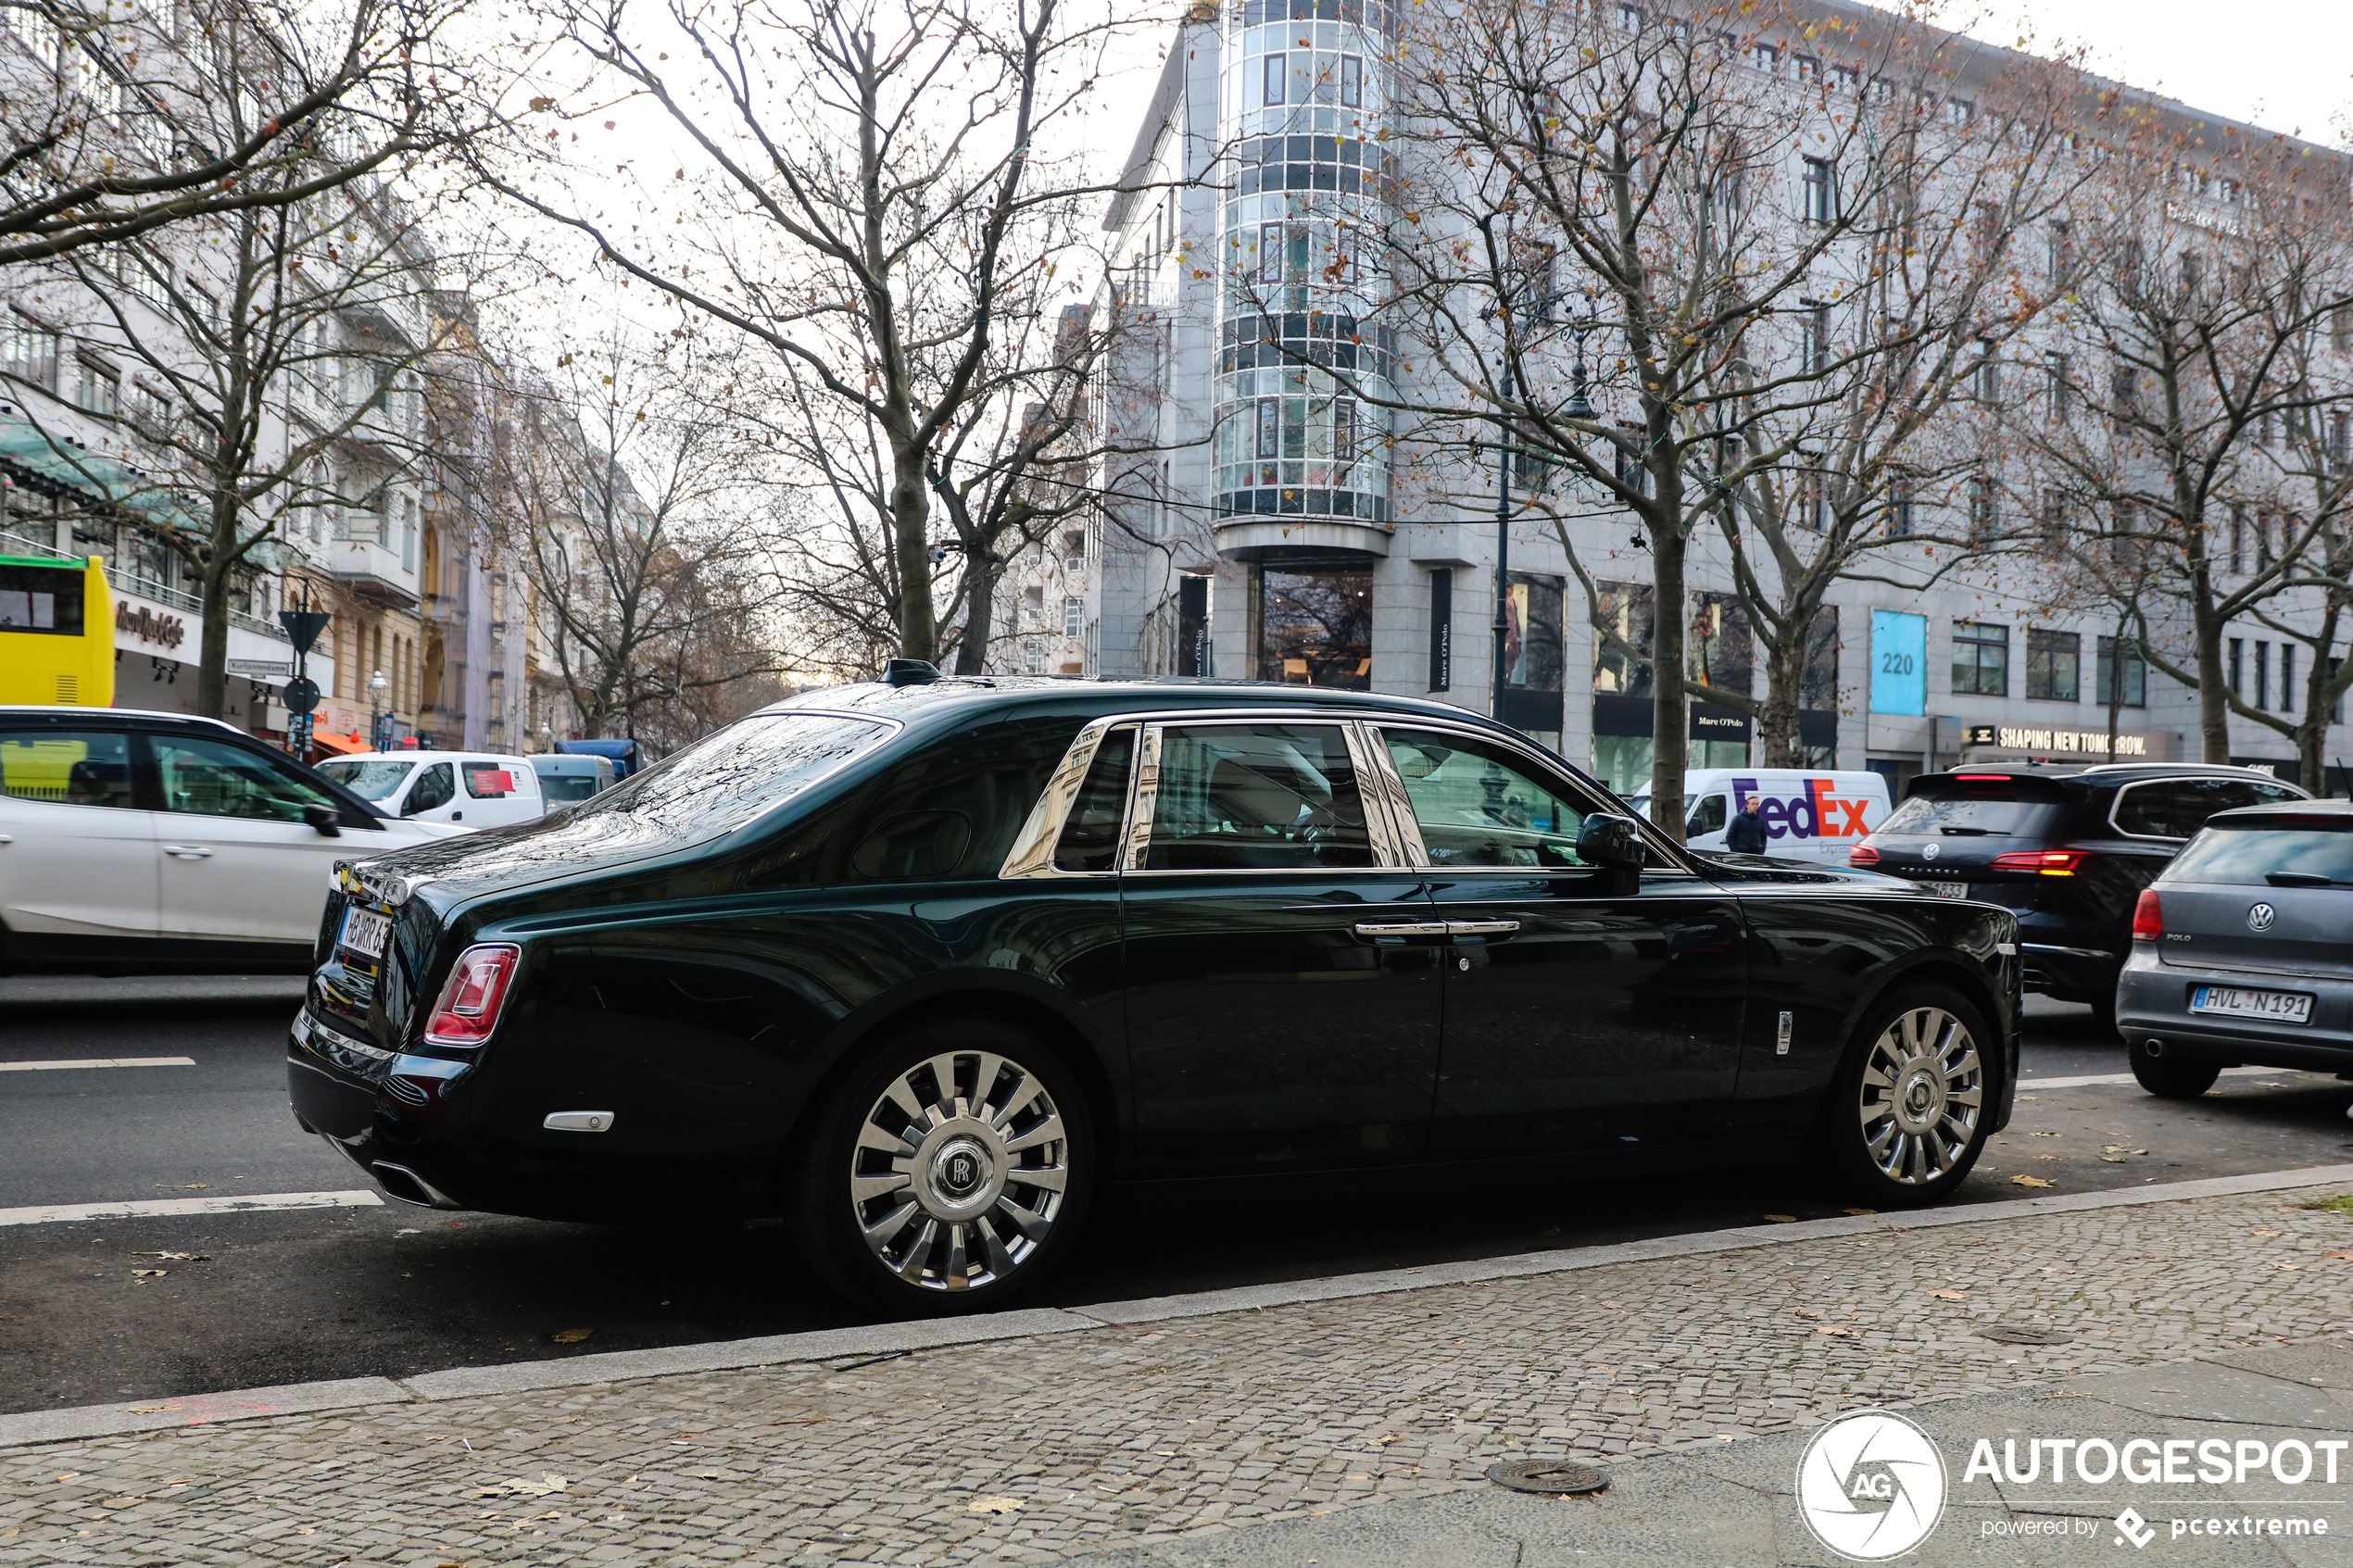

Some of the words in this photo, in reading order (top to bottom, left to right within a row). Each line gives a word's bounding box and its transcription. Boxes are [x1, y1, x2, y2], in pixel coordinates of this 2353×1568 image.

[1882, 652, 1913, 675] 220
[1698, 716, 1718, 726] Marc
[1719, 718, 1743, 728] O'Polo
[1999, 727, 2052, 750] SHAPING
[2053, 731, 2080, 752] NEW
[2167, 933, 2192, 943] POLO
[2206, 988, 2241, 1010] HVL
